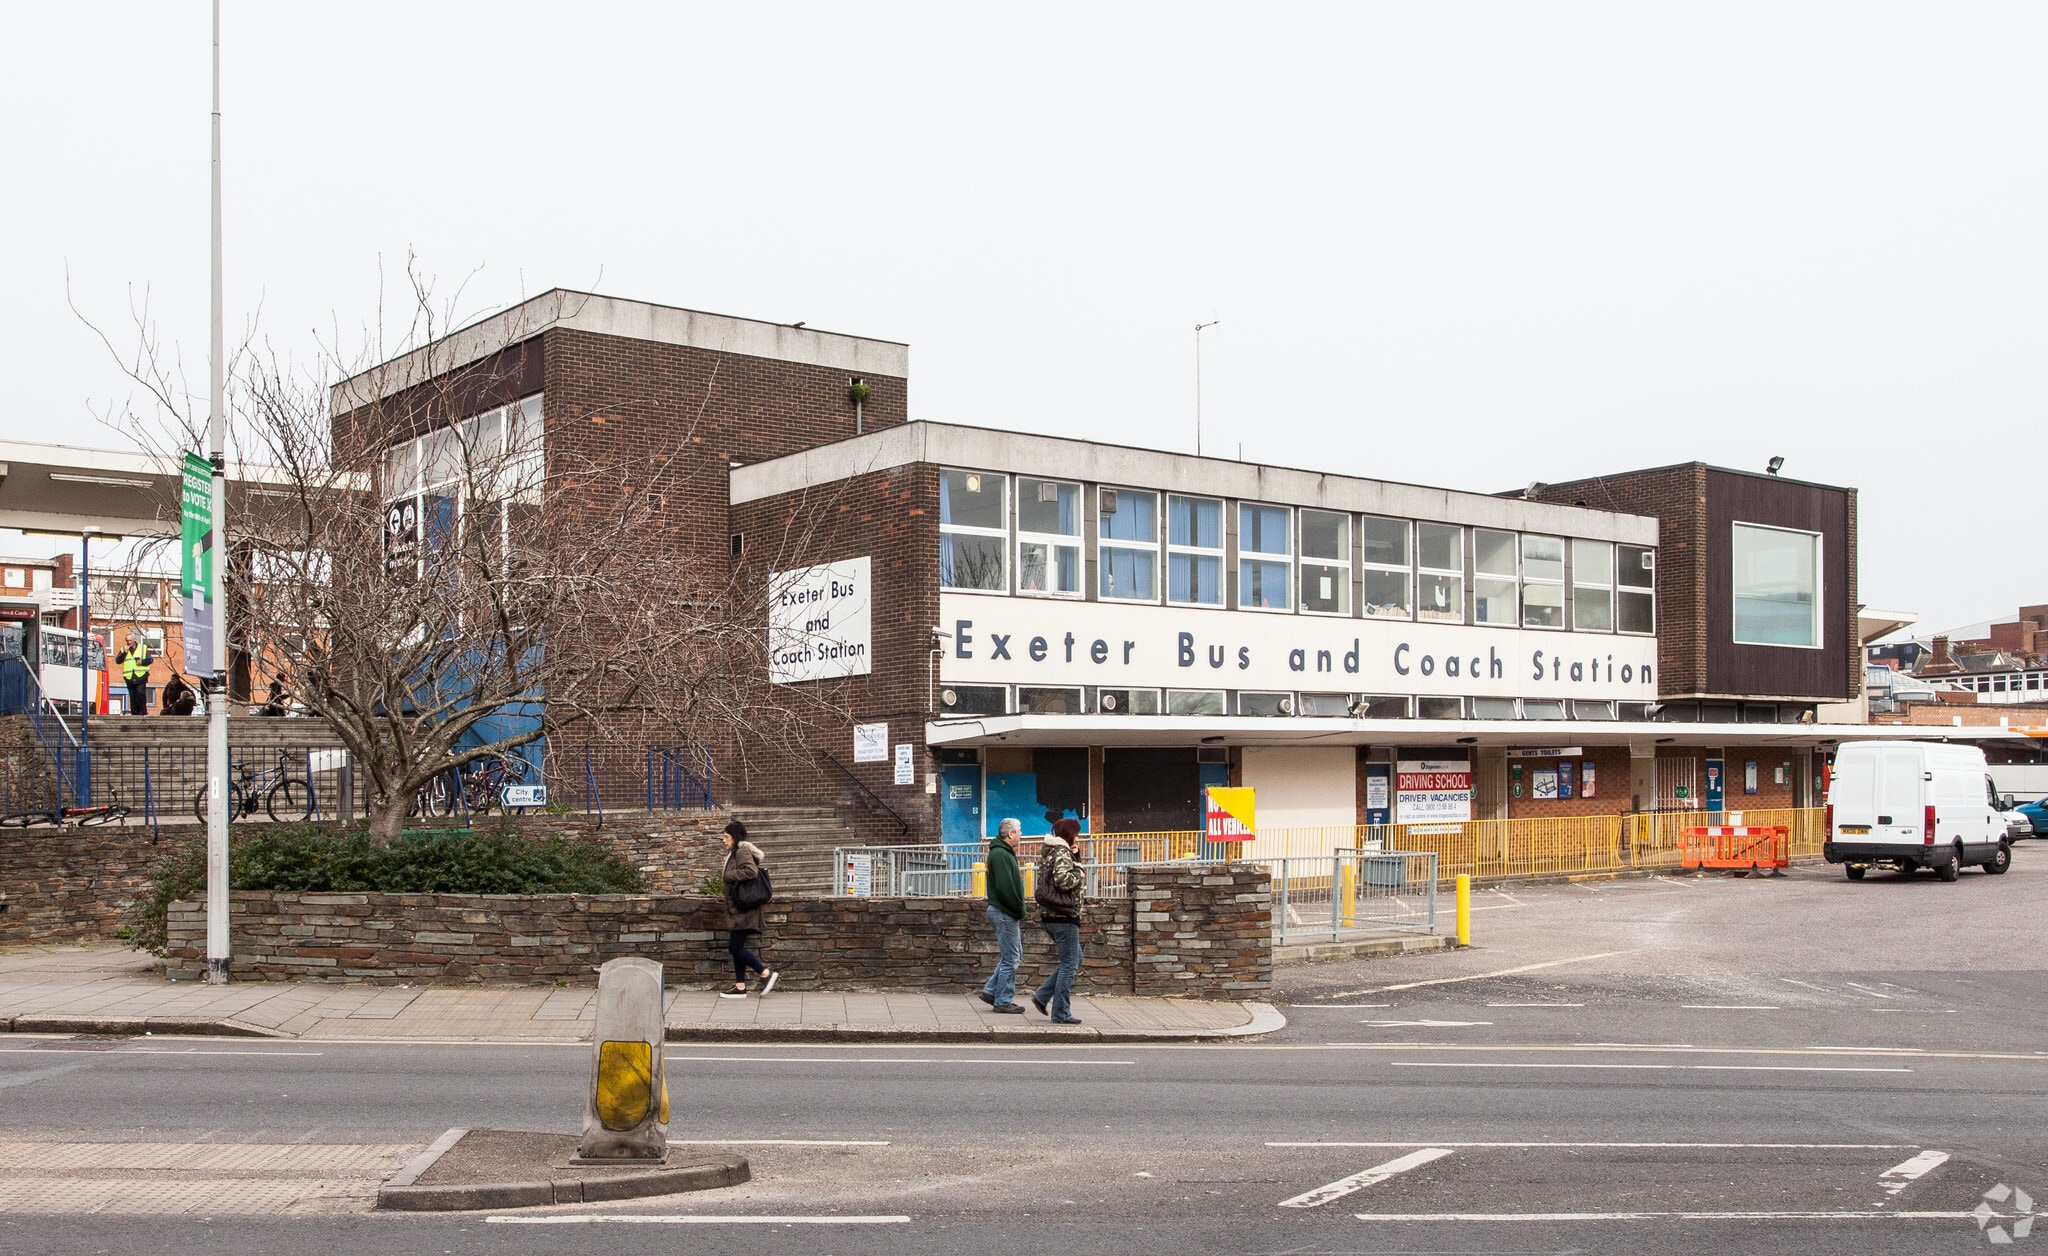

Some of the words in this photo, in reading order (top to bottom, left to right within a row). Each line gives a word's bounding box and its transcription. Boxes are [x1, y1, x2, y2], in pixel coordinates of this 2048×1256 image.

[184, 472, 212, 496] REGISTER
[183, 489, 190, 503] to
[190, 491, 206, 510] VOTE
[782, 588, 824, 606] Exeter
[831, 581, 854, 599] Bus
[806, 611, 830, 632] and
[773, 643, 812, 665] Coach
[818, 640, 865, 661] Station
[956, 620, 1135, 665] Exeter
[1178, 631, 1250, 669] Bus
[1288, 638, 1360, 674] and
[1394, 643, 1503, 679] Coach
[1533, 650, 1652, 684] Station
[1400, 774, 1433, 789] DRIVING
[1435, 774, 1468, 788] SCHOOL
[1208, 795, 1219, 813] NO
[1400, 794, 1426, 802] DRIVER
[1430, 794, 1469, 802] VACANCIES
[1208, 818, 1222, 836] ALL
